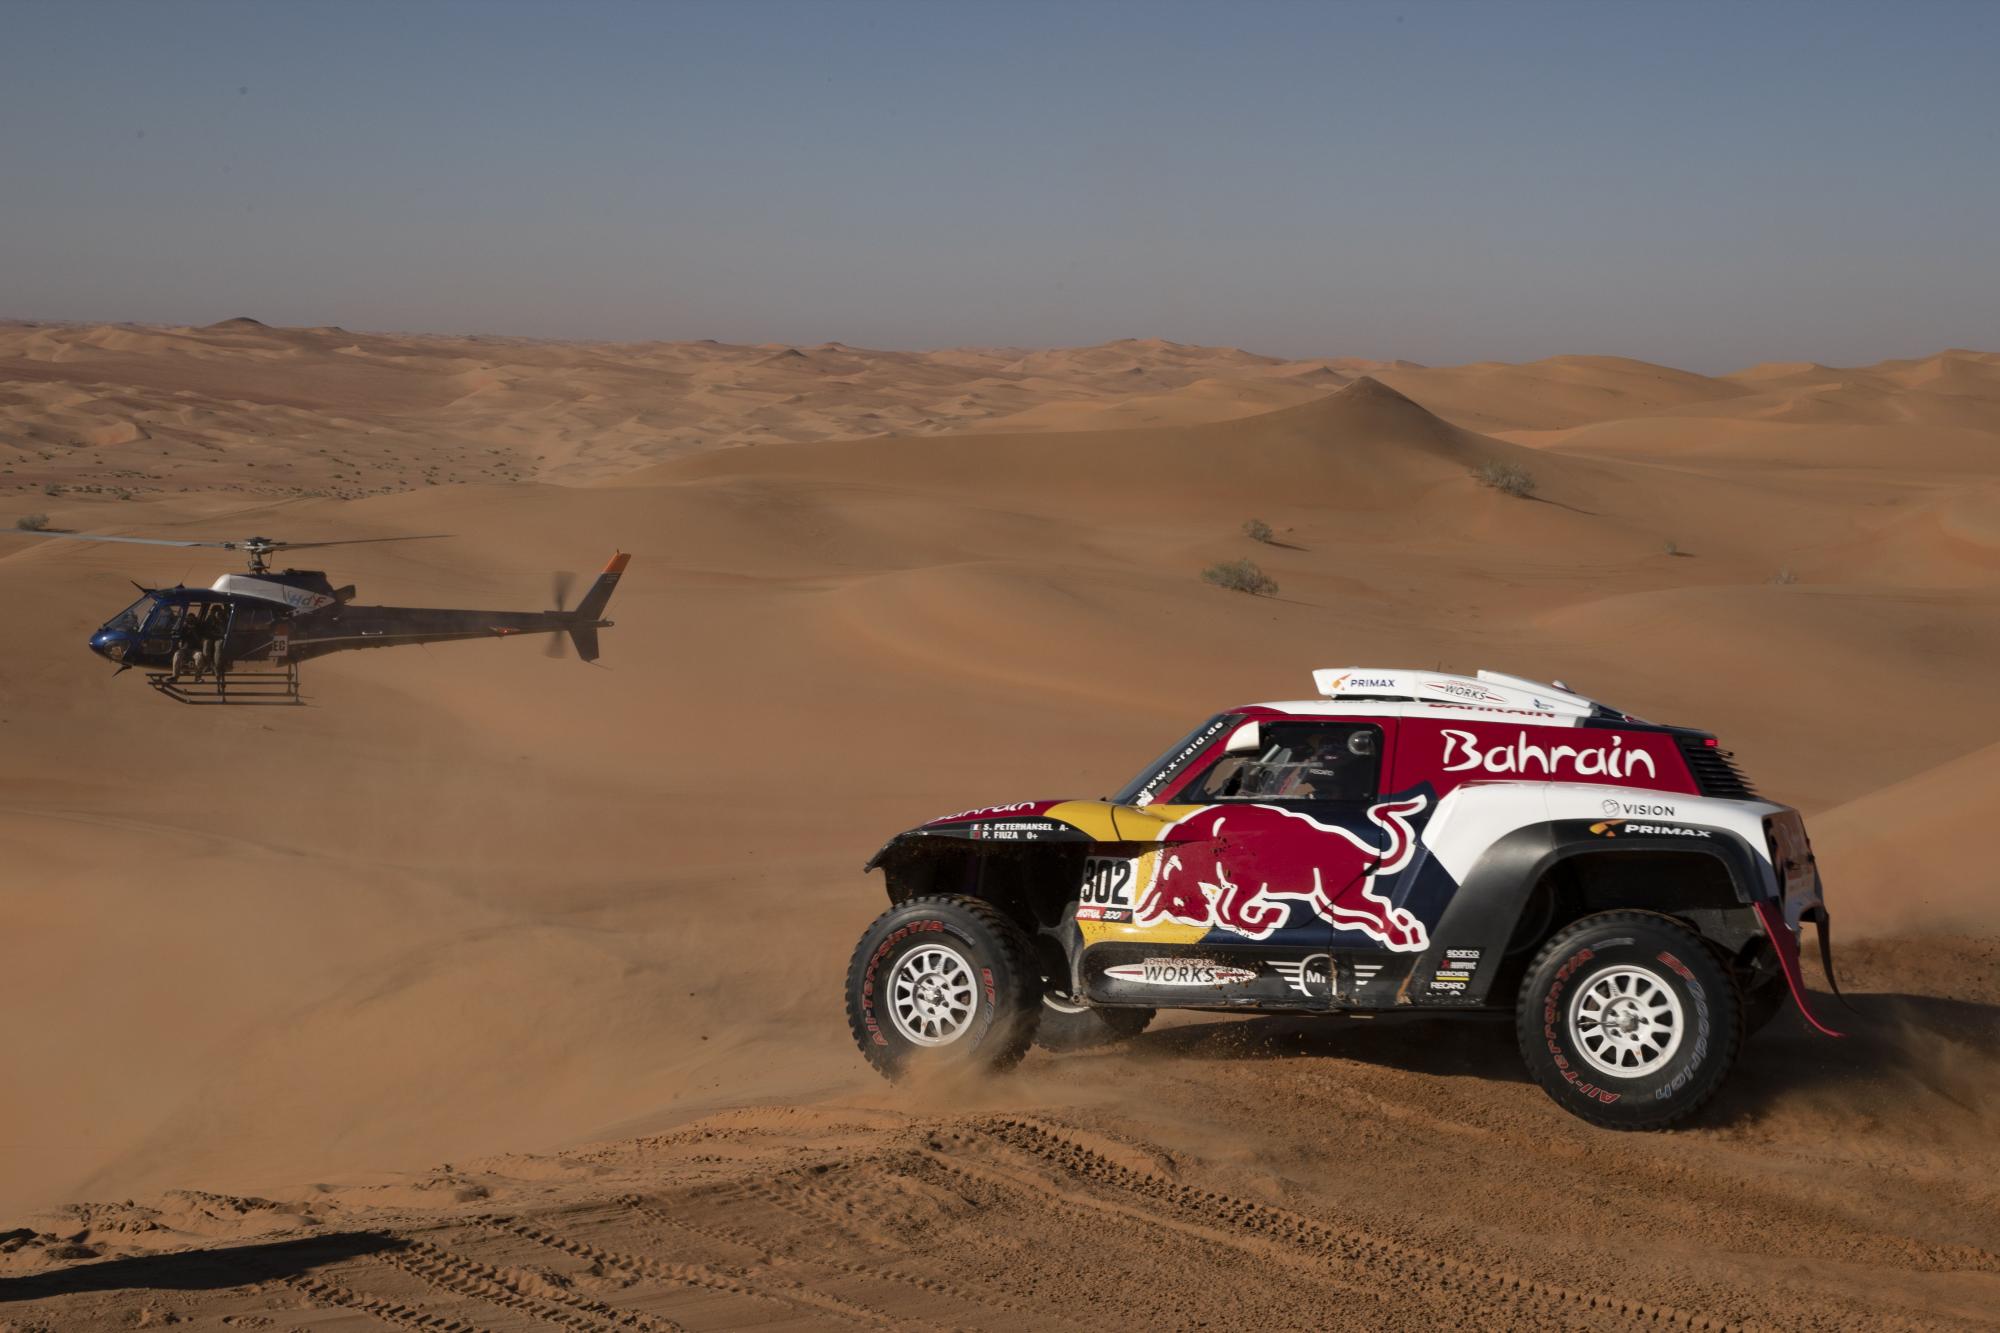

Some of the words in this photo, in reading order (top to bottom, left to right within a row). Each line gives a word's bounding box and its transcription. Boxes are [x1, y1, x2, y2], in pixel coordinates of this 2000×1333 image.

[1350, 679, 1396, 688] PRIMAX
[1445, 684, 1487, 700] WORKS
[1137, 721, 1224, 798] www.x-raid.de
[1440, 729, 1656, 779] Bahrain
[1623, 803, 1676, 817] VISION
[994, 823, 1054, 831] PETERHANSEL
[1624, 824, 1712, 838] PRIMAX
[982, 831, 992, 839] P.
[994, 831, 1019, 840] FIUZA
[1080, 859, 1131, 905] 302
[1144, 966, 1215, 983] WORKS
[1430, 982, 1467, 990] RECARO
